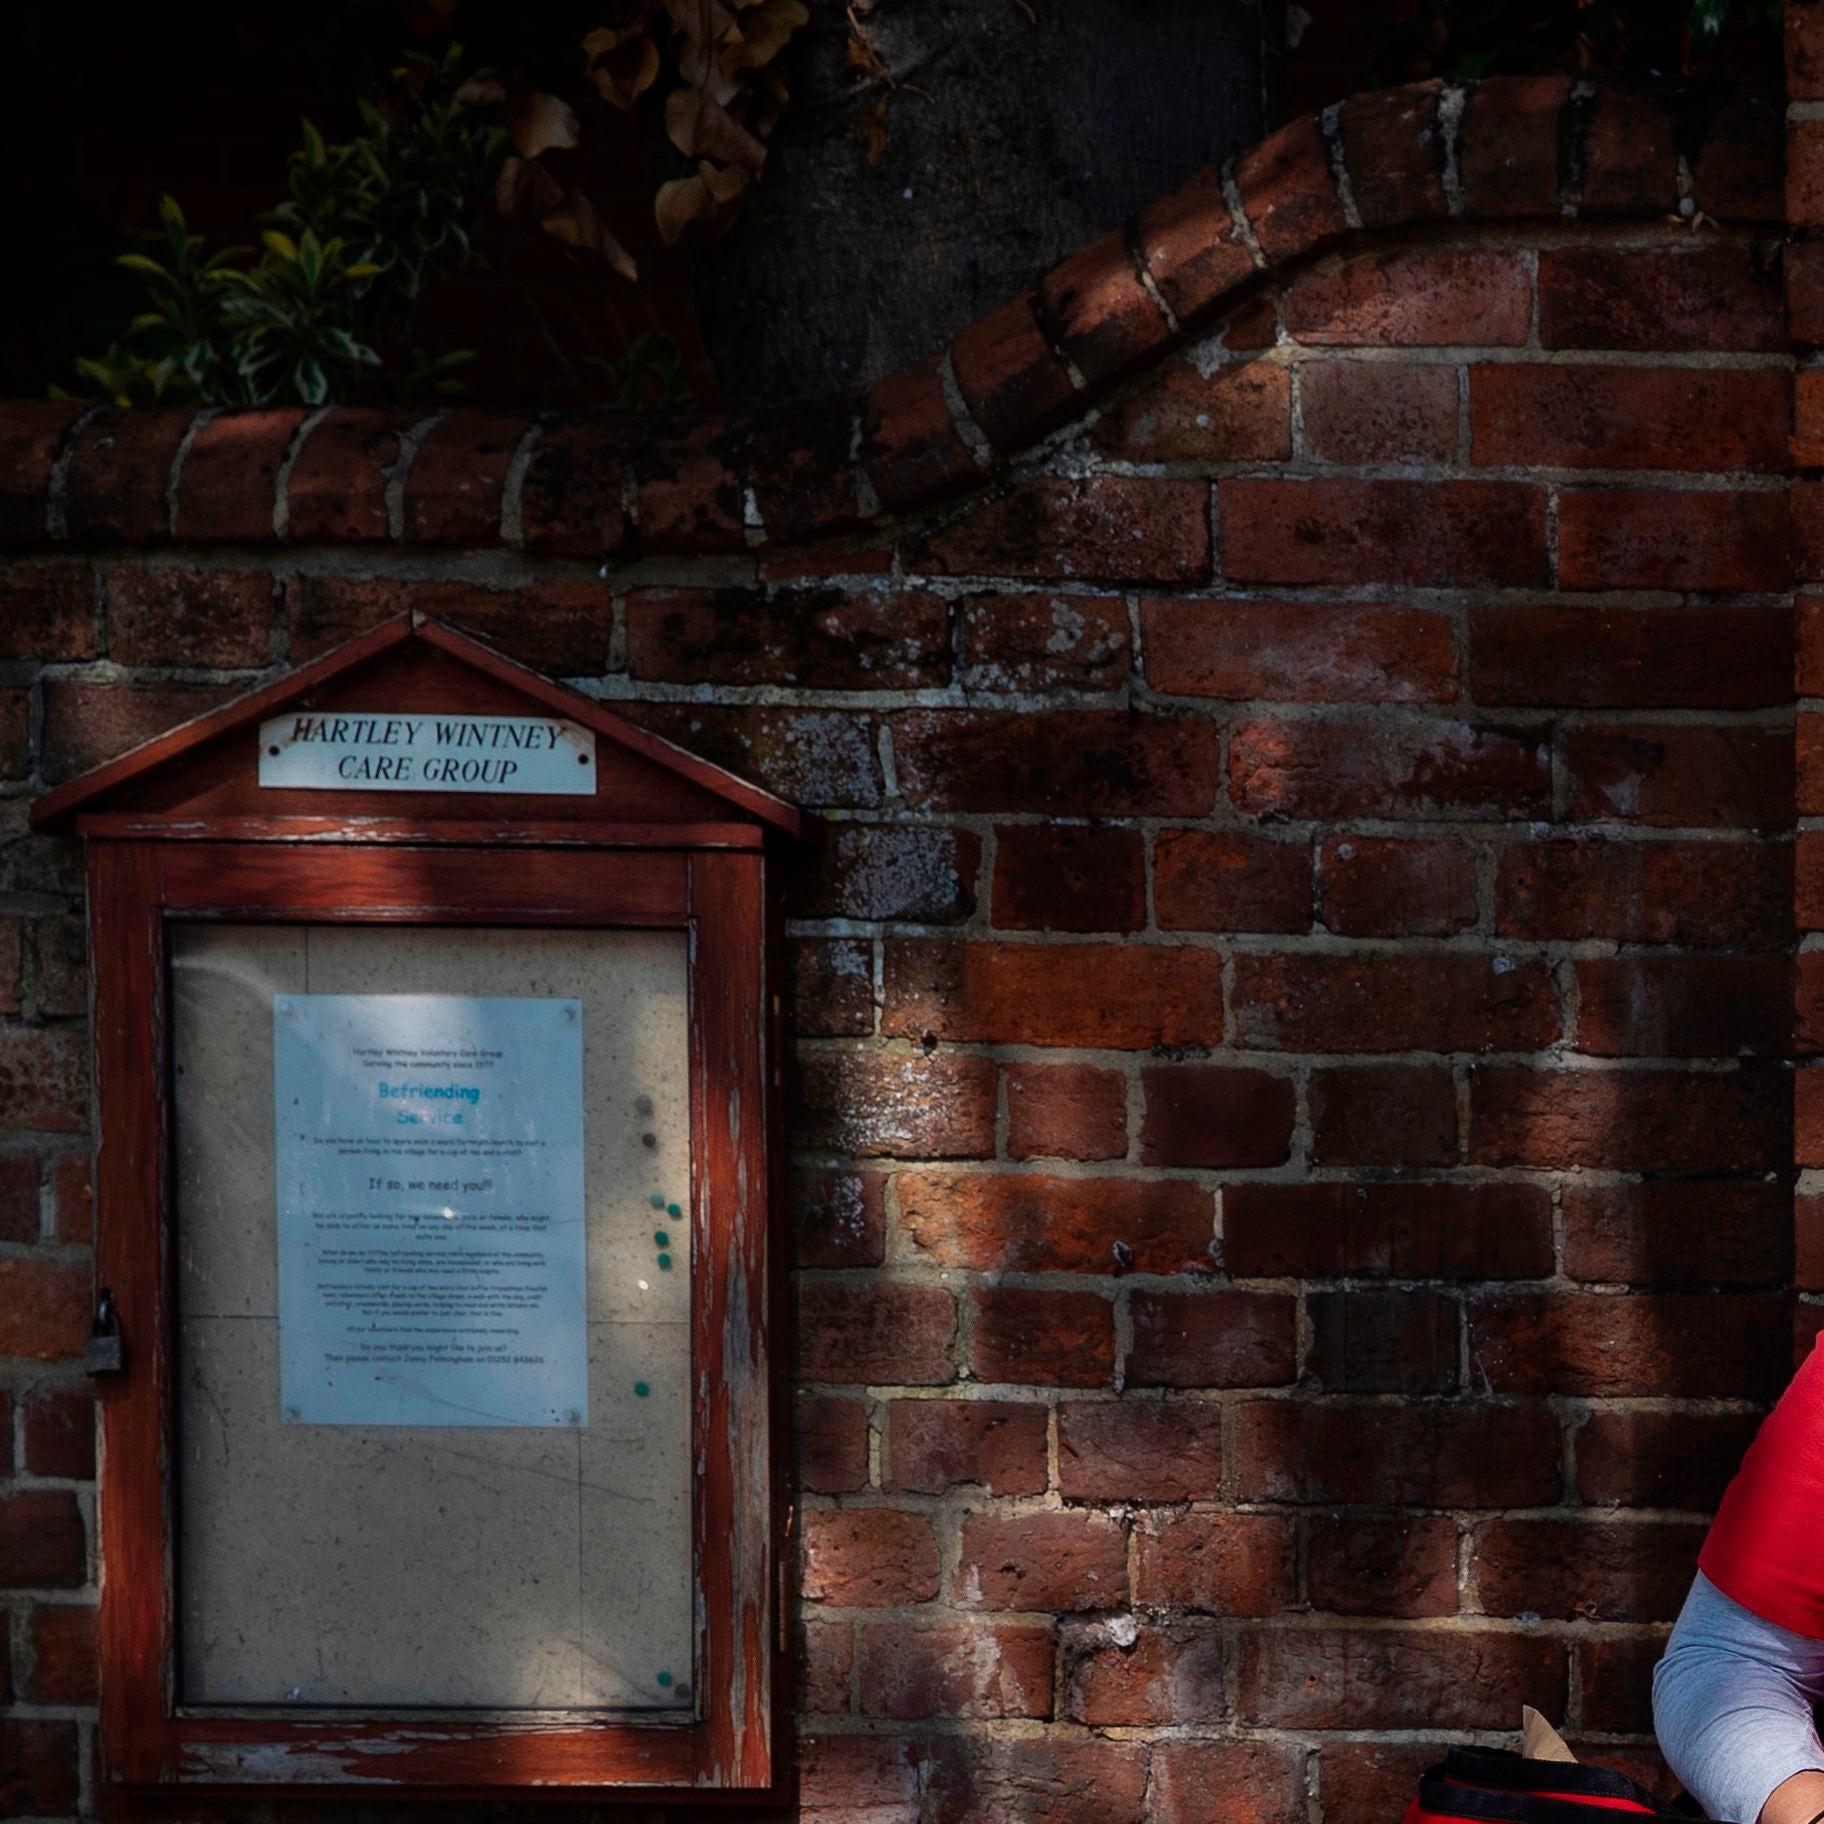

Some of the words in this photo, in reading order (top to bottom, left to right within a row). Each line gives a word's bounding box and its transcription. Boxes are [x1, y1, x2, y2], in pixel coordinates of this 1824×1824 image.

[291, 718, 424, 746] HARTLEY
[435, 721, 564, 750] WINTNEY
[338, 756, 412, 781] CARE
[423, 759, 517, 784] GROUP
[379, 1083, 480, 1105] Befriending
[368, 1177, 383, 1190] If
[407, 1180, 425, 1191] we
[428, 1178, 459, 1191] need
